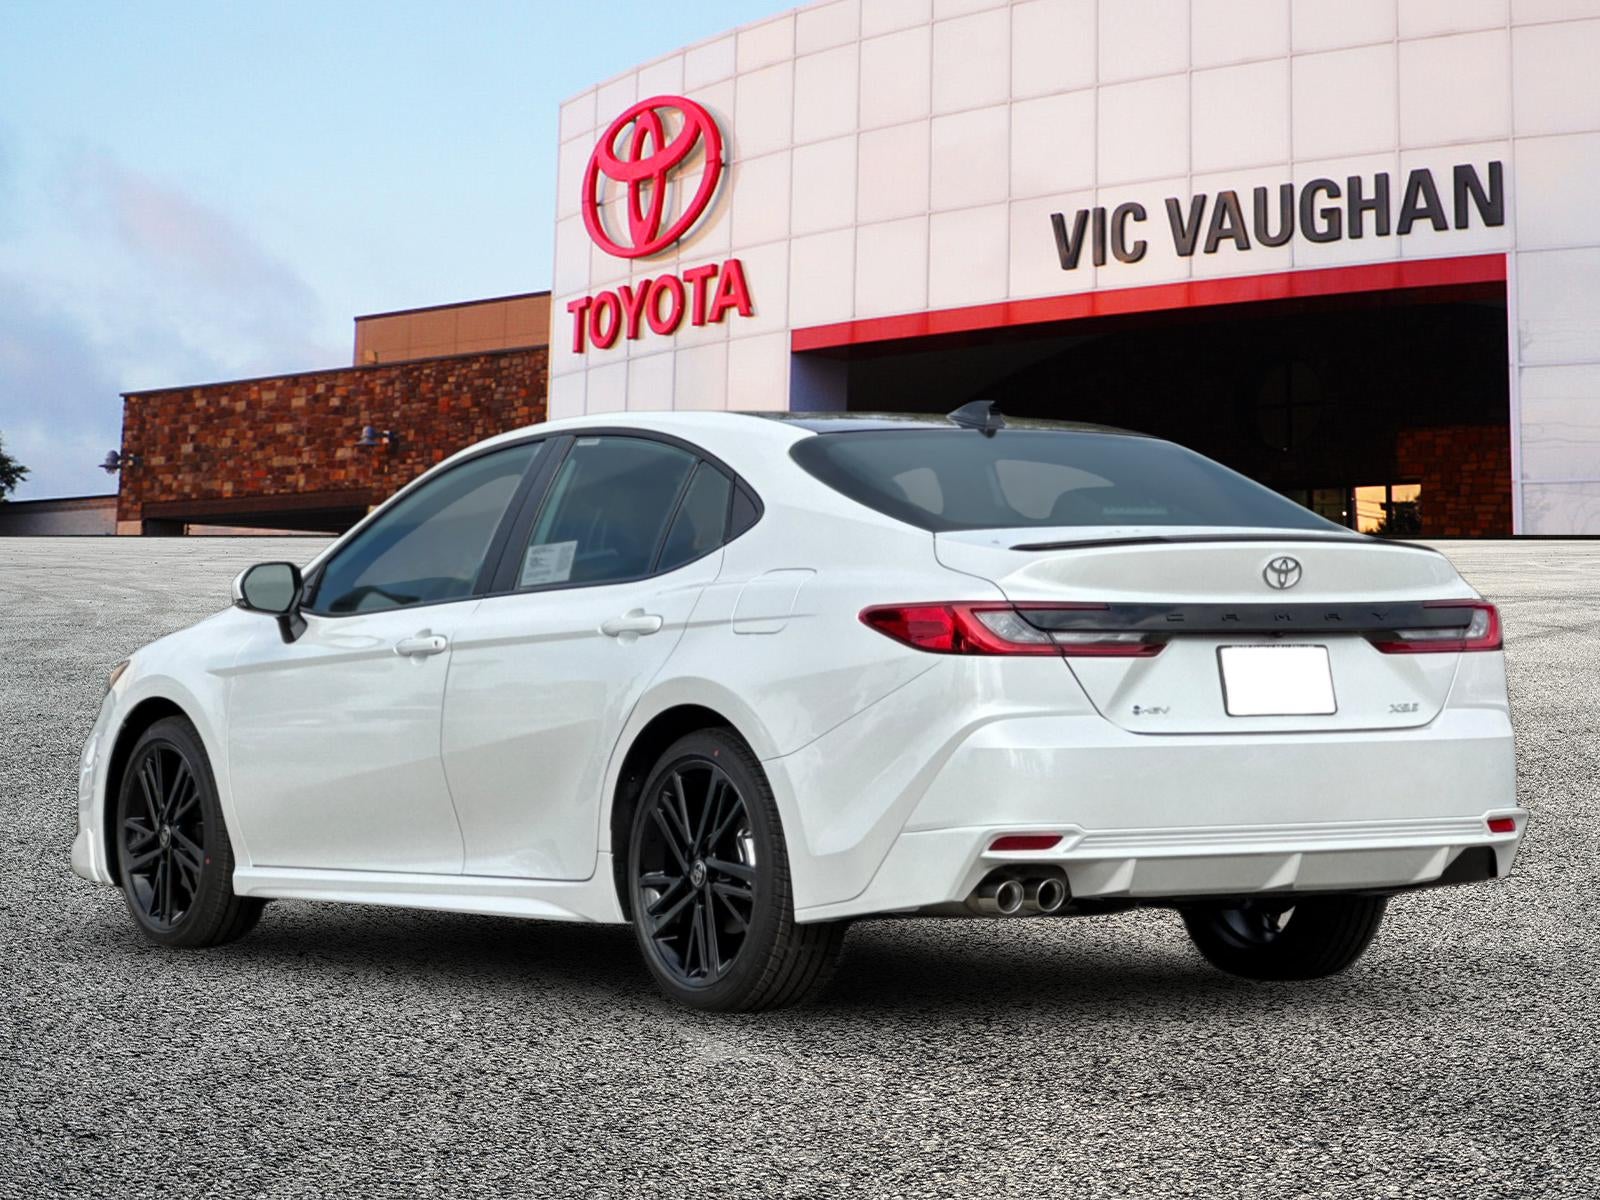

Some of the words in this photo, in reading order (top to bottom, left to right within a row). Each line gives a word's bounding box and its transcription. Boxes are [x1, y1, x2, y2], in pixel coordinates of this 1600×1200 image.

[1050, 201, 1148, 270] VIC
[1165, 160, 1505, 258] VAUGHAN
[567, 258, 754, 353] TOYOTA
